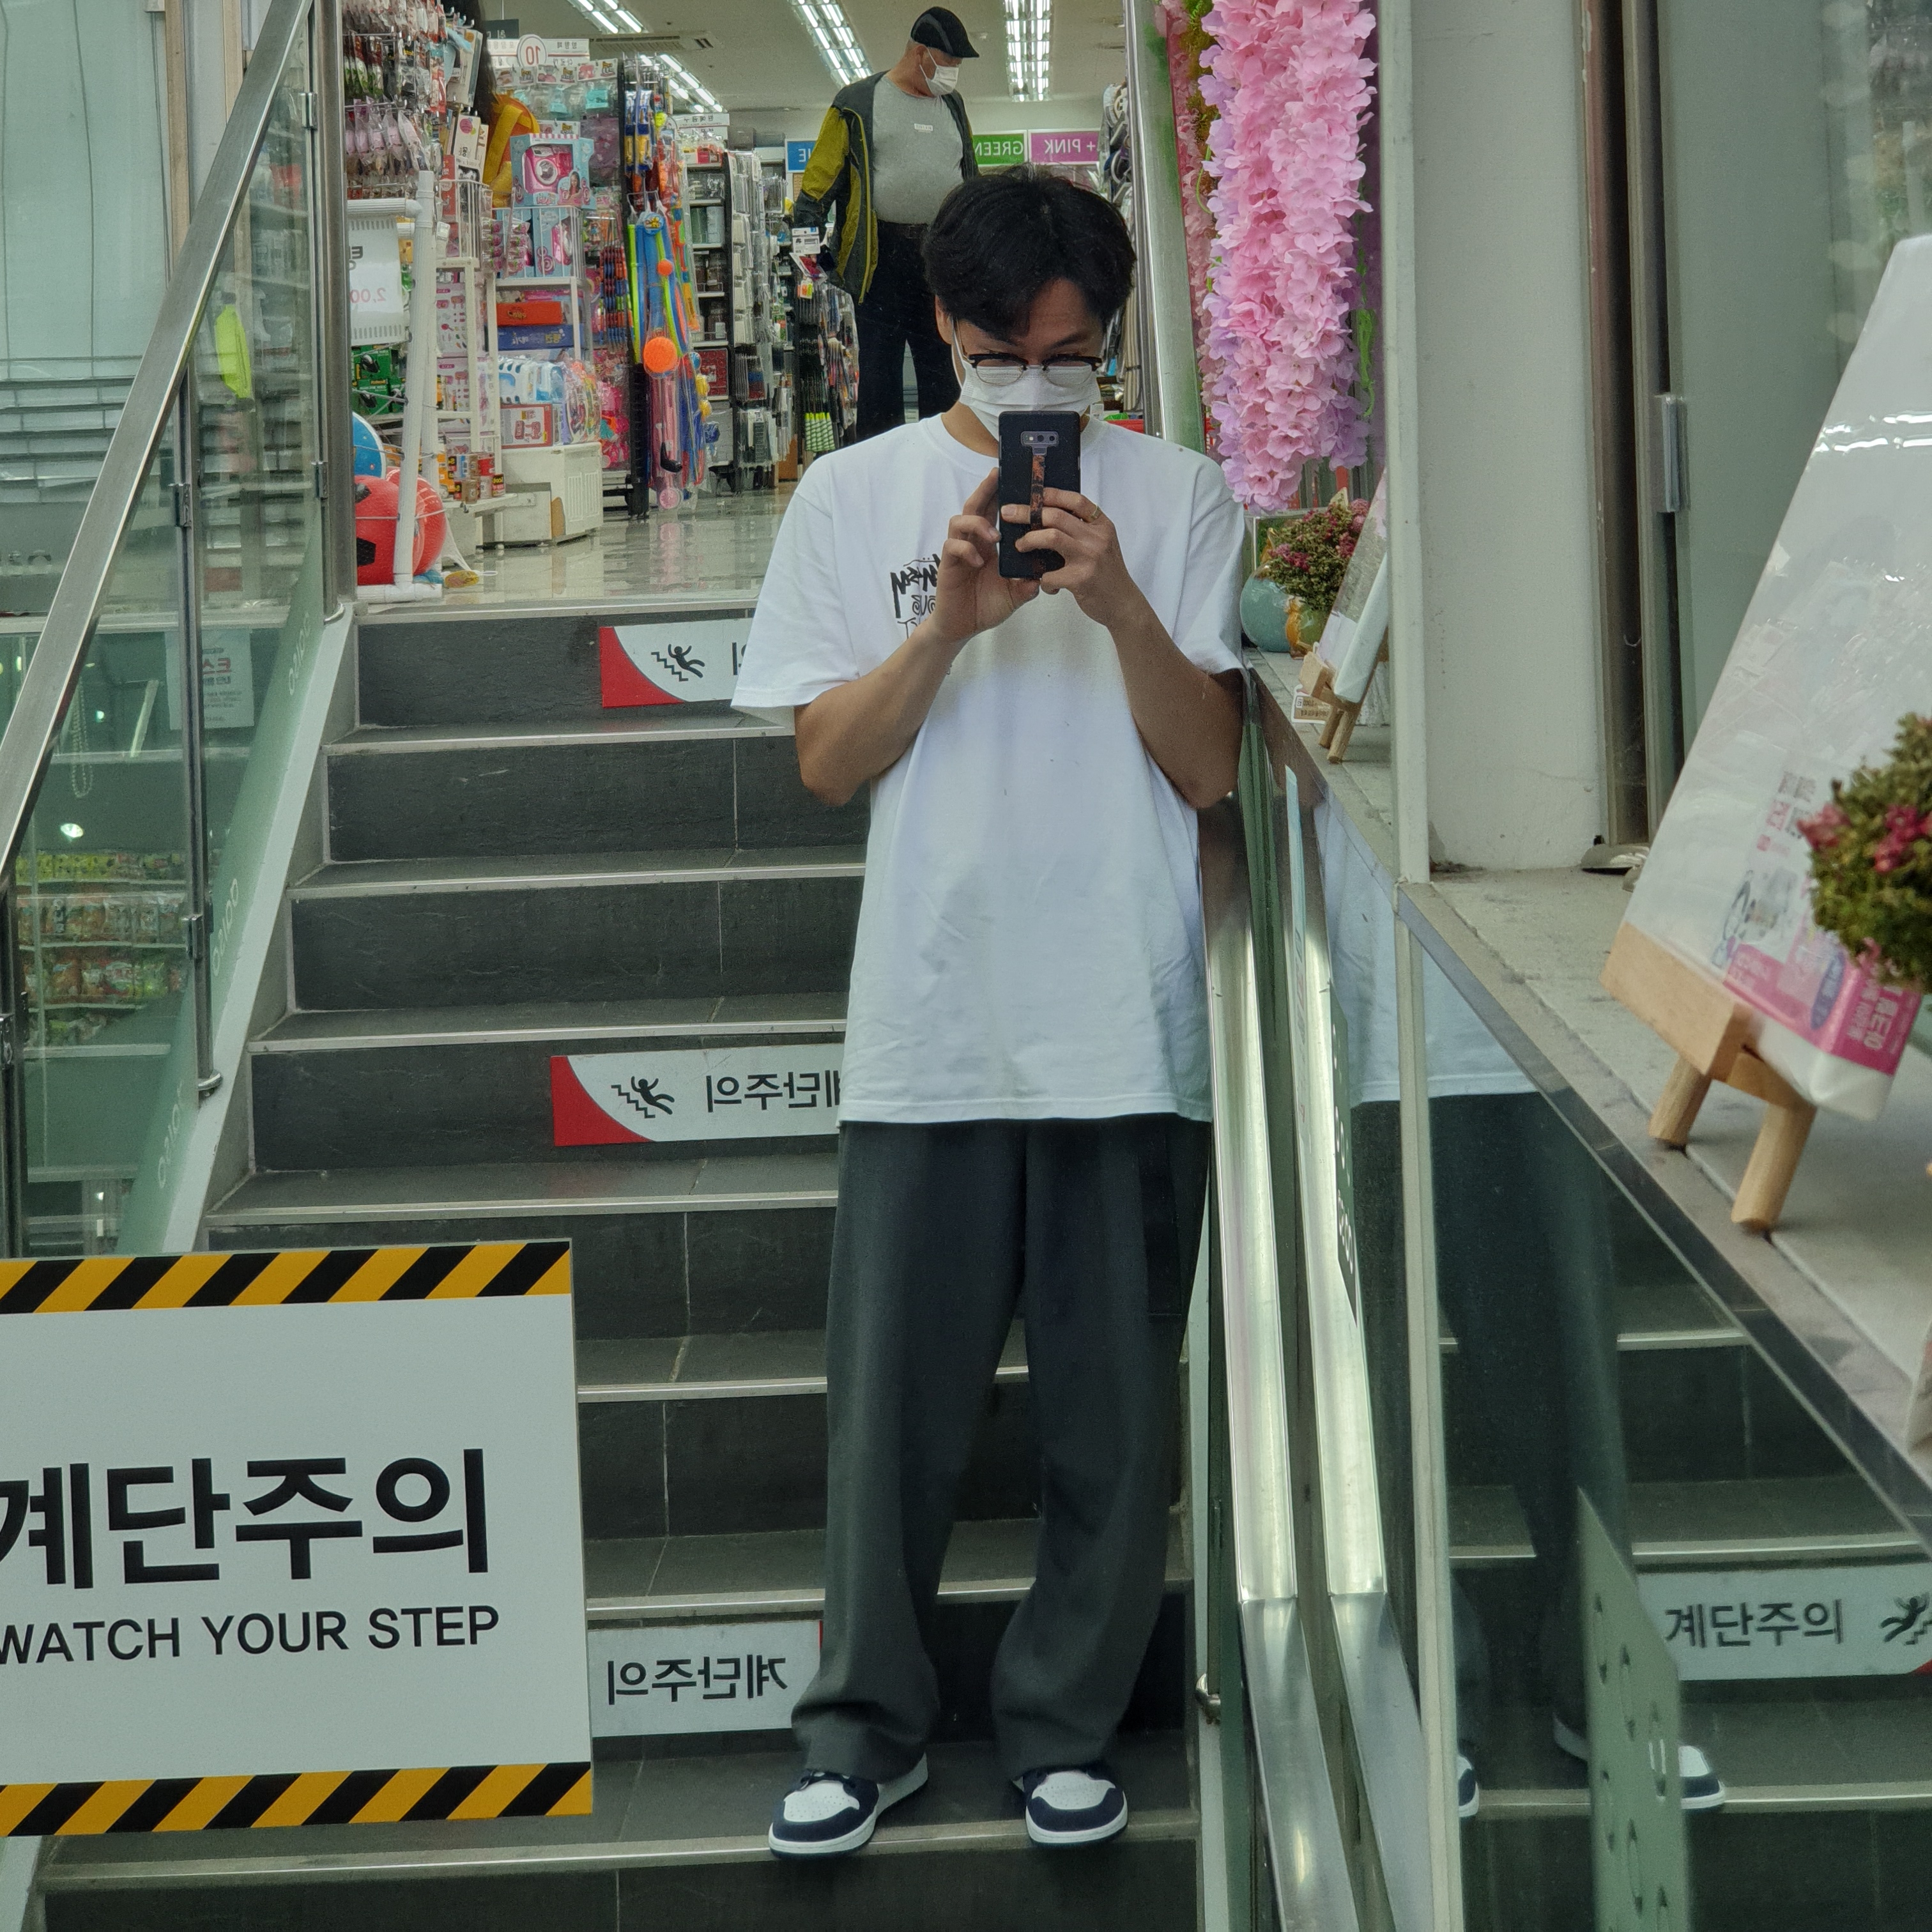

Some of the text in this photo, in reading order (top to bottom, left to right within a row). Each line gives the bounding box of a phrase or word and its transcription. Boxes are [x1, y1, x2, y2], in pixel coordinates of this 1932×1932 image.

[0, 1448, 489, 1590] 계단주의
[0, 1606, 500, 1664] WATCH YOUR STEP
[1664, 1597, 1843, 1650] 계단주의
